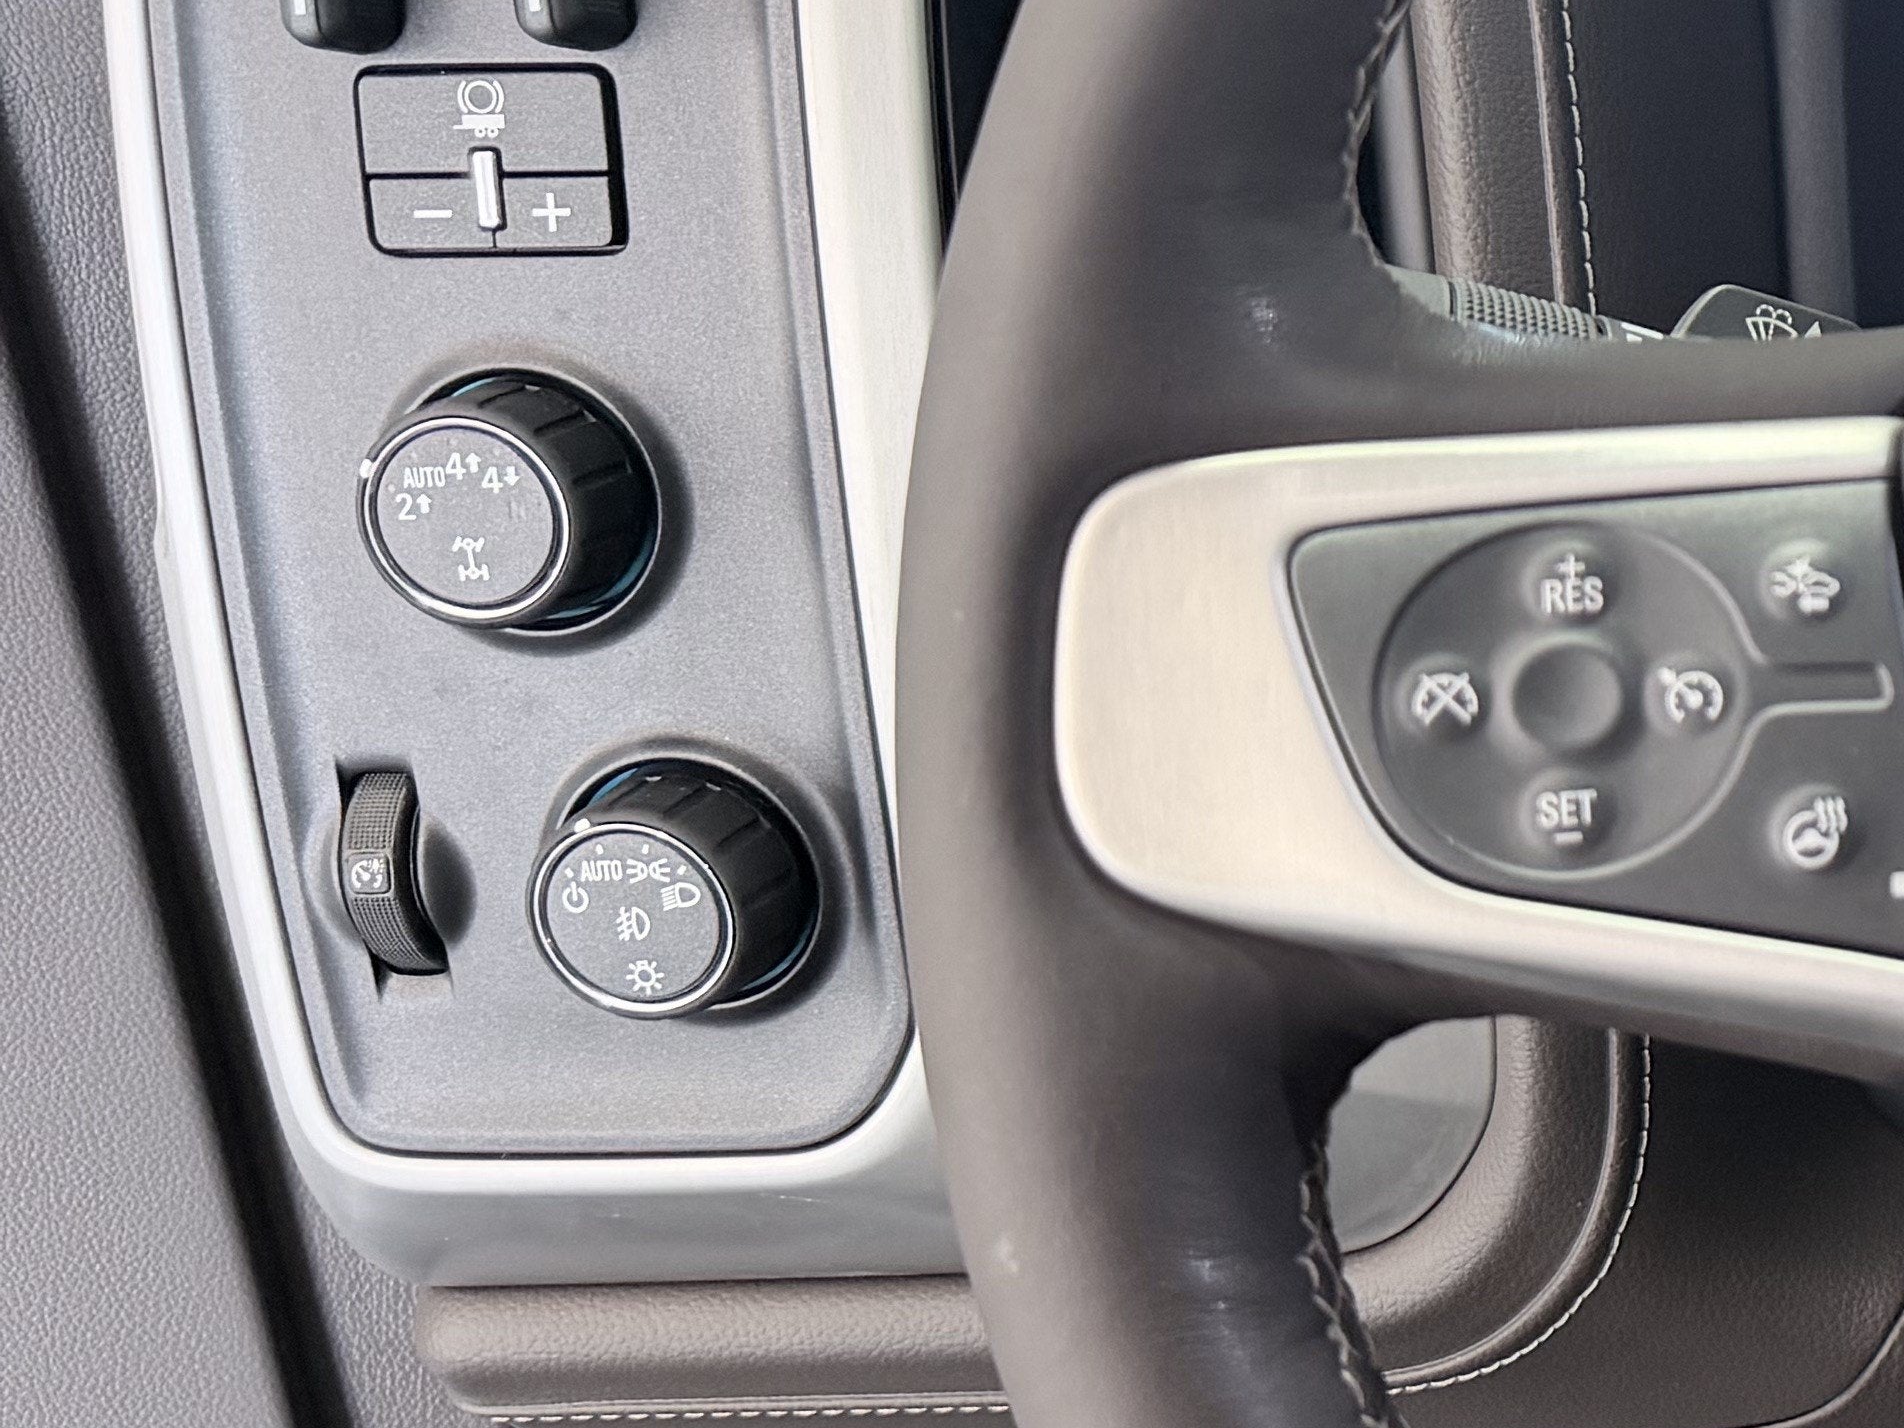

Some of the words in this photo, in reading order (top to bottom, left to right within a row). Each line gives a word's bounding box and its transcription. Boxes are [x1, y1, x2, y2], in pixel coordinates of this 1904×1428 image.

[403, 466, 446, 489] AUTO
[395, 492, 418, 521] 2
[1542, 577, 1604, 615] RES
[1536, 788, 1598, 827] SET
[580, 859, 623, 883] AUTO
